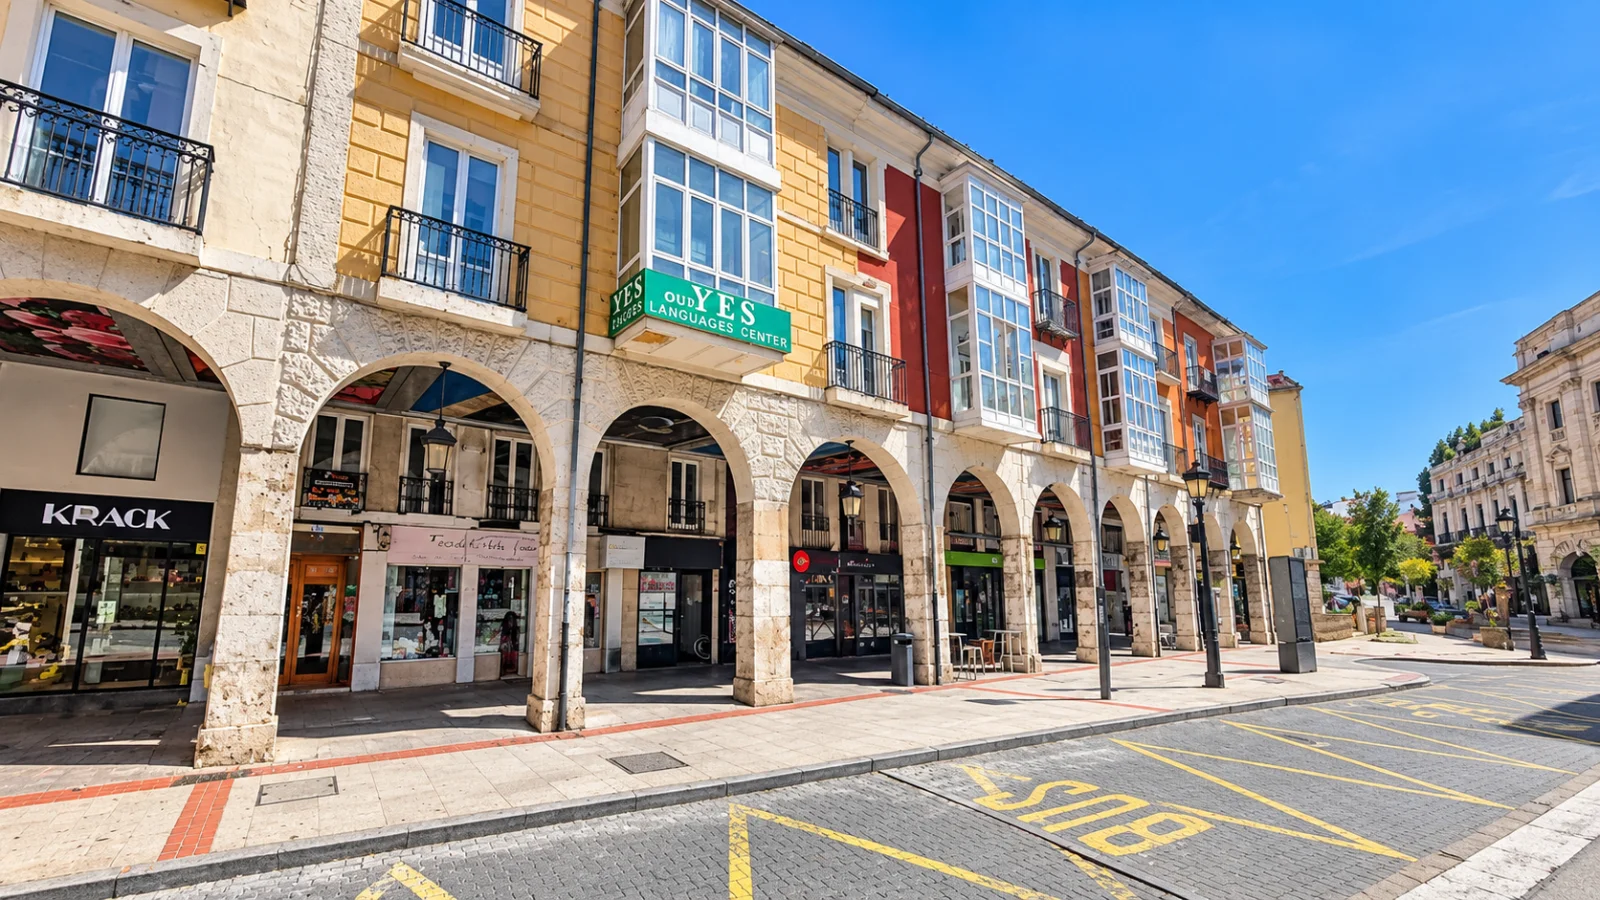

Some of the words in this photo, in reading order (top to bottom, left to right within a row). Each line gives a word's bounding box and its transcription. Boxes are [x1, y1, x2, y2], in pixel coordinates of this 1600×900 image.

[612, 274, 643, 316] YES
[664, 291, 695, 308] OUD
[691, 285, 756, 326] YES
[649, 300, 734, 334] LANGUAGES
[741, 326, 787, 348] CENTER
[42, 502, 172, 531] KRACK
[972, 780, 1215, 856] BUS
